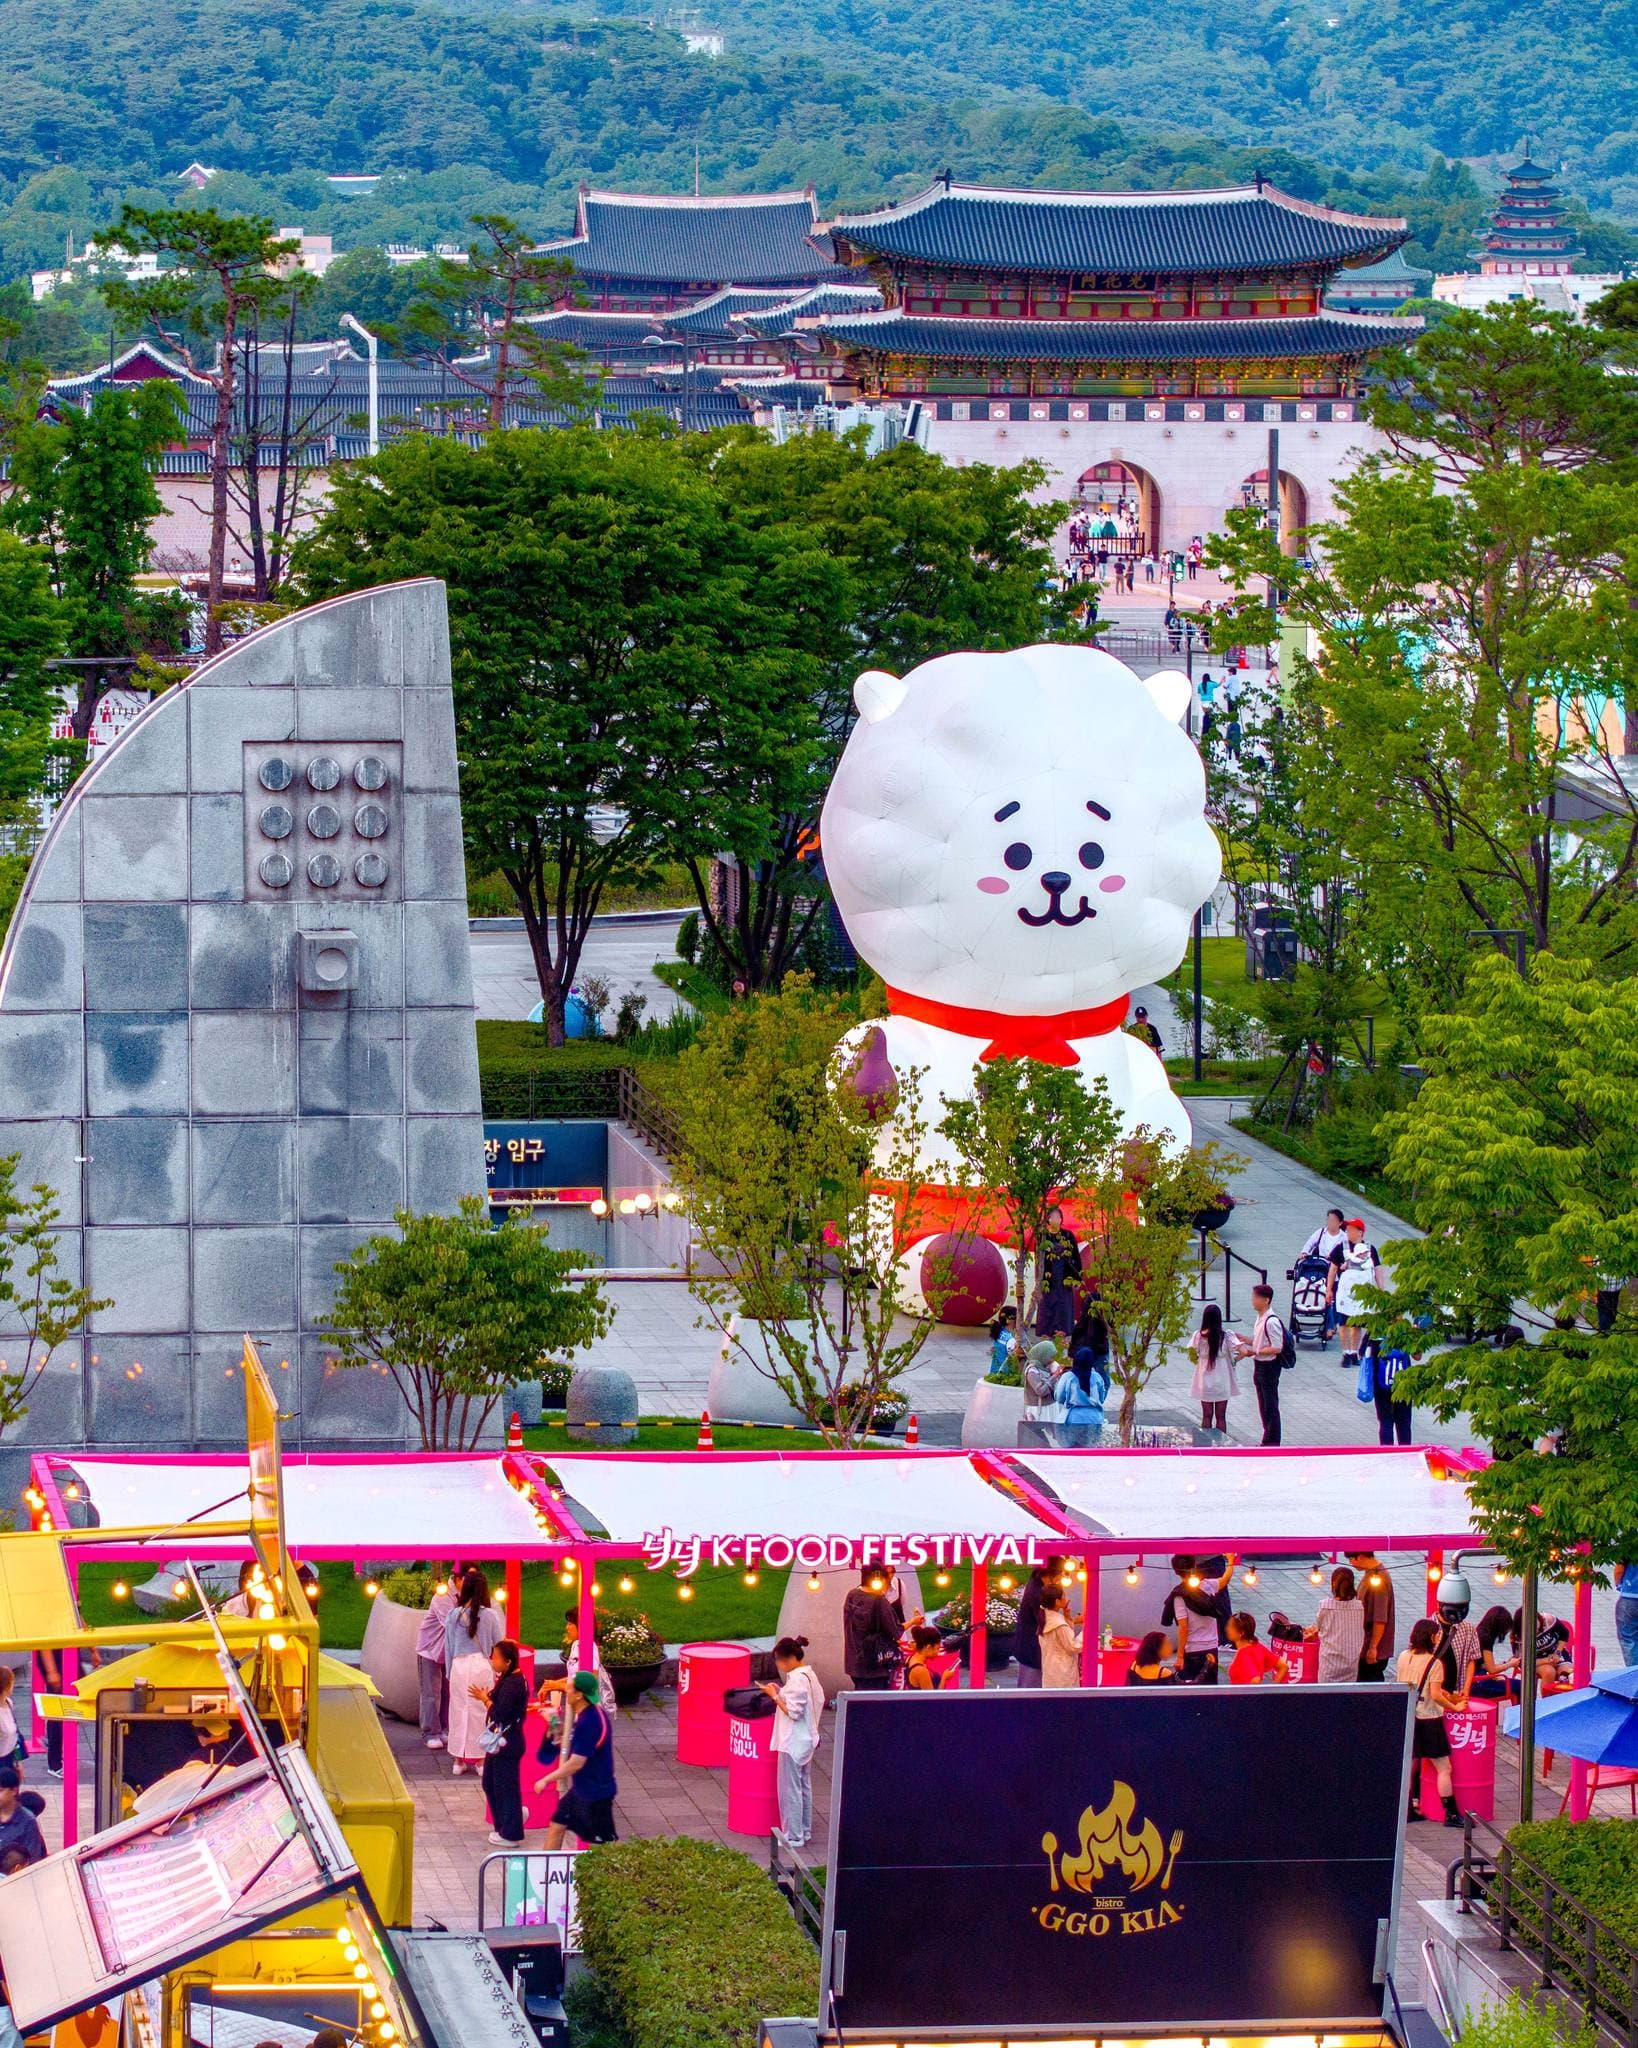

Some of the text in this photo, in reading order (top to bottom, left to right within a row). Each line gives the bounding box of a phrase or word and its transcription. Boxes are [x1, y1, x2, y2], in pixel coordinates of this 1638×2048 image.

[507, 1138, 546, 1162] 입구
[711, 1534, 854, 1567] K-FOOD
[861, 1534, 1044, 1567] FESTIVAL
[1095, 1899, 1124, 1908] bistro
[1039, 1903, 1111, 1936] GGO
